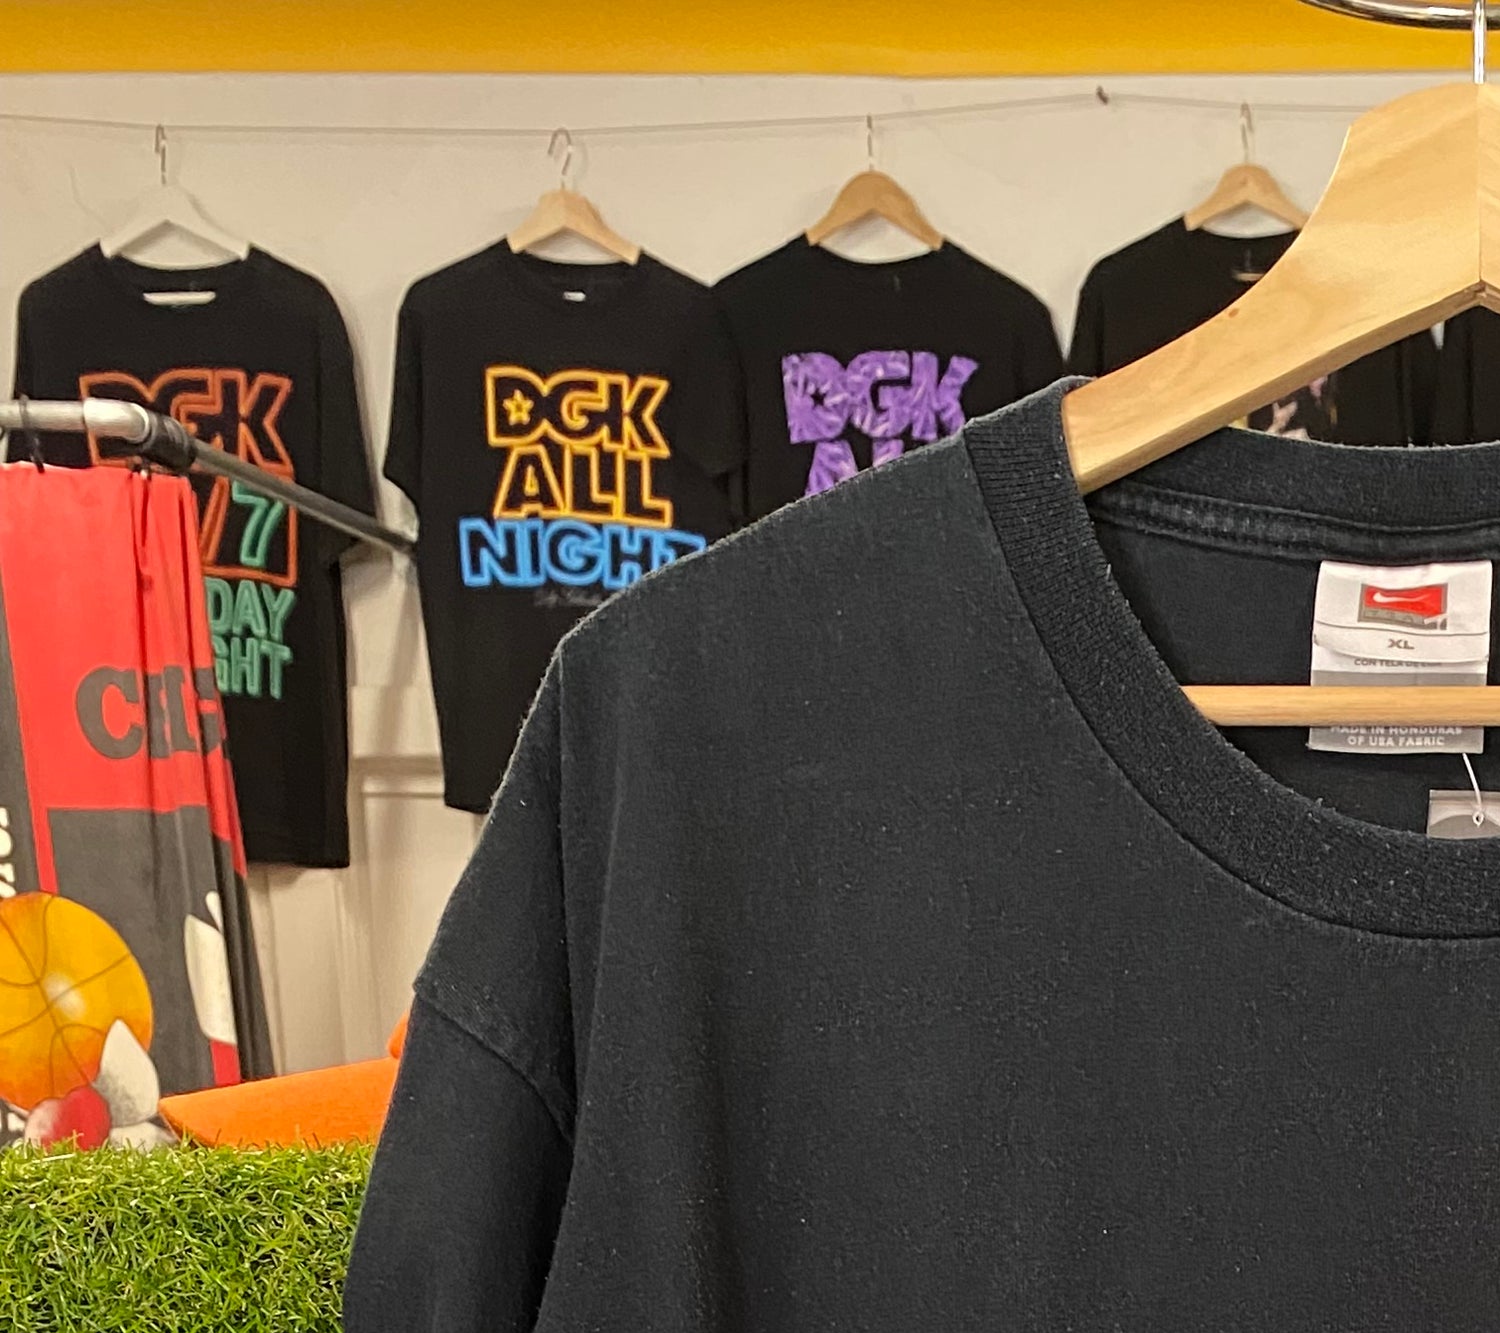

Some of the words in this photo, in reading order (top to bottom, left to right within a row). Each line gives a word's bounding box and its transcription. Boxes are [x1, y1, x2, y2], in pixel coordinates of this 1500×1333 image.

[485, 364, 672, 459] DGK
[781, 349, 980, 441] DGK
[493, 444, 674, 528] ALL
[206, 576, 296, 642] DAY
[1387, 638, 1415, 650] XL
[1330, 726, 1367, 734] MADE
[1371, 726, 1385, 734] IN
[1388, 726, 1463, 736] HONDURAS
[1347, 735, 1365, 746] OF
[1368, 736, 1395, 746] USA
[1398, 736, 1445, 747] FABRIC
